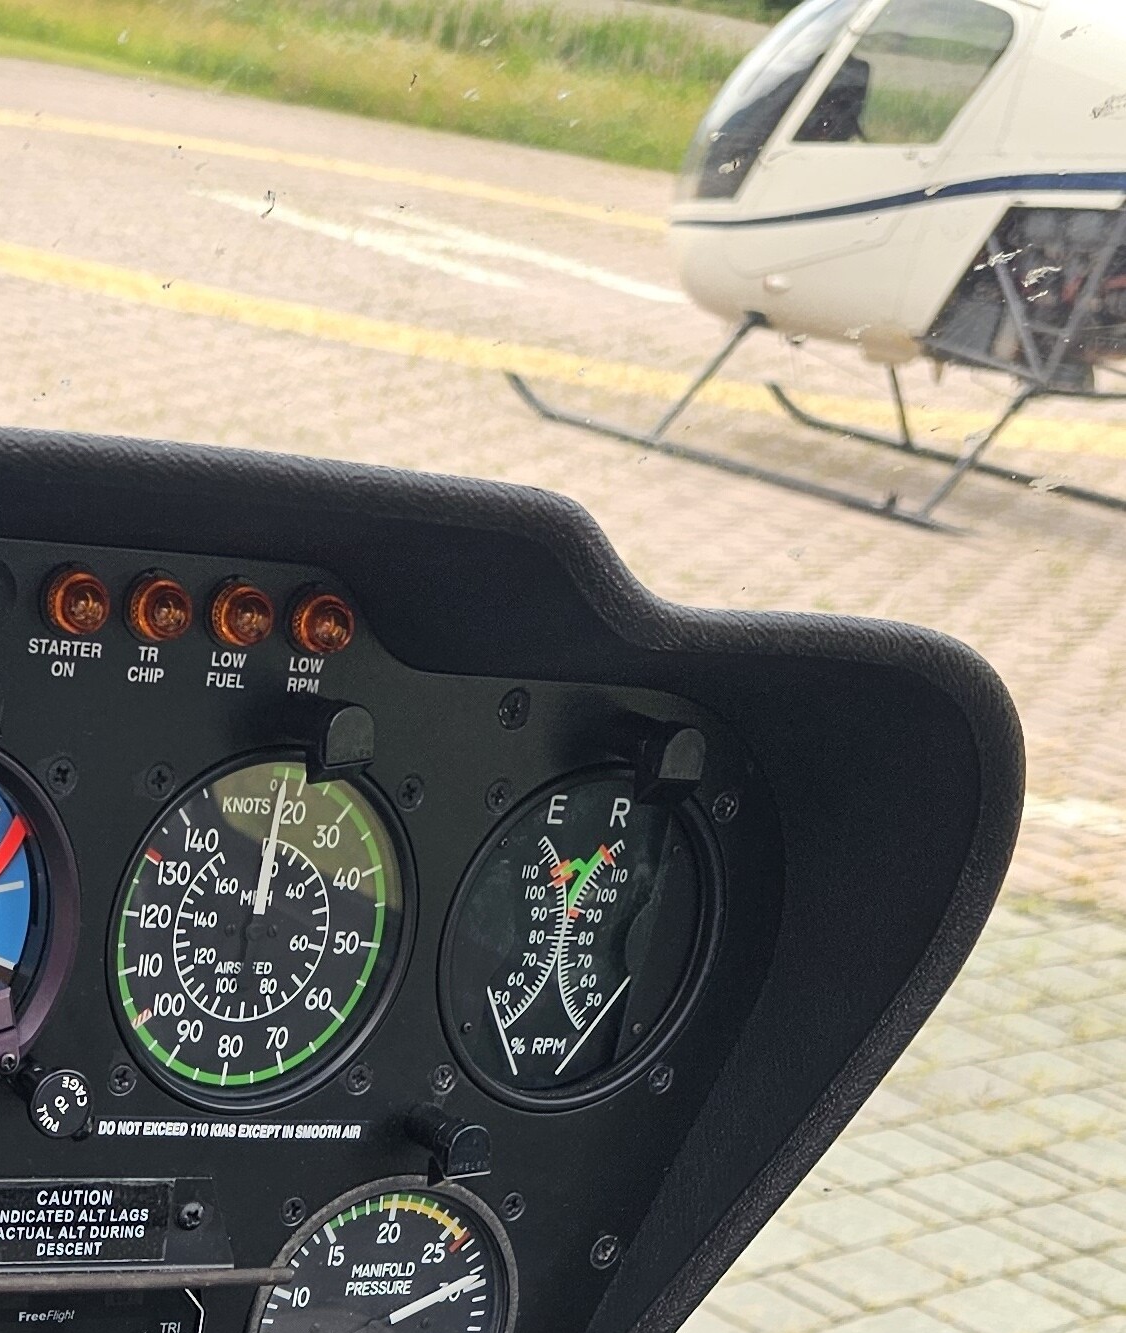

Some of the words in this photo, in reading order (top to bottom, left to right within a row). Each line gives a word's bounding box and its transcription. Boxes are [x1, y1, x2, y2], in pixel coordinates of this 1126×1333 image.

[28, 638, 103, 658] STARTER
[138, 646, 159, 663] TR
[211, 651, 247, 669] LOW
[288, 657, 324, 674] LOW
[50, 661, 75, 677] ON
[127, 666, 164, 684] CHIP
[206, 672, 245, 689] FUEL
[286, 677, 319, 694] RPM
[222, 797, 271, 814] KNOTS
[547, 794, 568, 824] E
[609, 798, 630, 828] R
[139, 904, 172, 929] 120
[510, 1038, 525, 1054] %
[531, 1038, 567, 1055] RPM
[98, 1120, 116, 1136] DO
[116, 1121, 143, 1136] NOT
[143, 1122, 189, 1137] EXCEED
[189, 1122, 210, 1137] 110
[209, 1123, 237, 1138] KIAS
[238, 1123, 281, 1139] EXCEPT
[281, 1124, 295, 1139] IN
[295, 1124, 340, 1139] SMOOTH
[340, 1124, 362, 1139] AIR
[36, 1190, 114, 1206] CAUTION
[78, 1209, 105, 1223] ALT
[109, 1208, 149, 1222] LAGS
[59, 1226, 86, 1240] ALT
[89, 1225, 145, 1240] DURING
[36, 1242, 102, 1256] DESCENT
[351, 1262, 415, 1278] MANIFOLD
[345, 1280, 413, 1297] PRESSURE
[18, 1309, 75, 1324] FreeFlight
